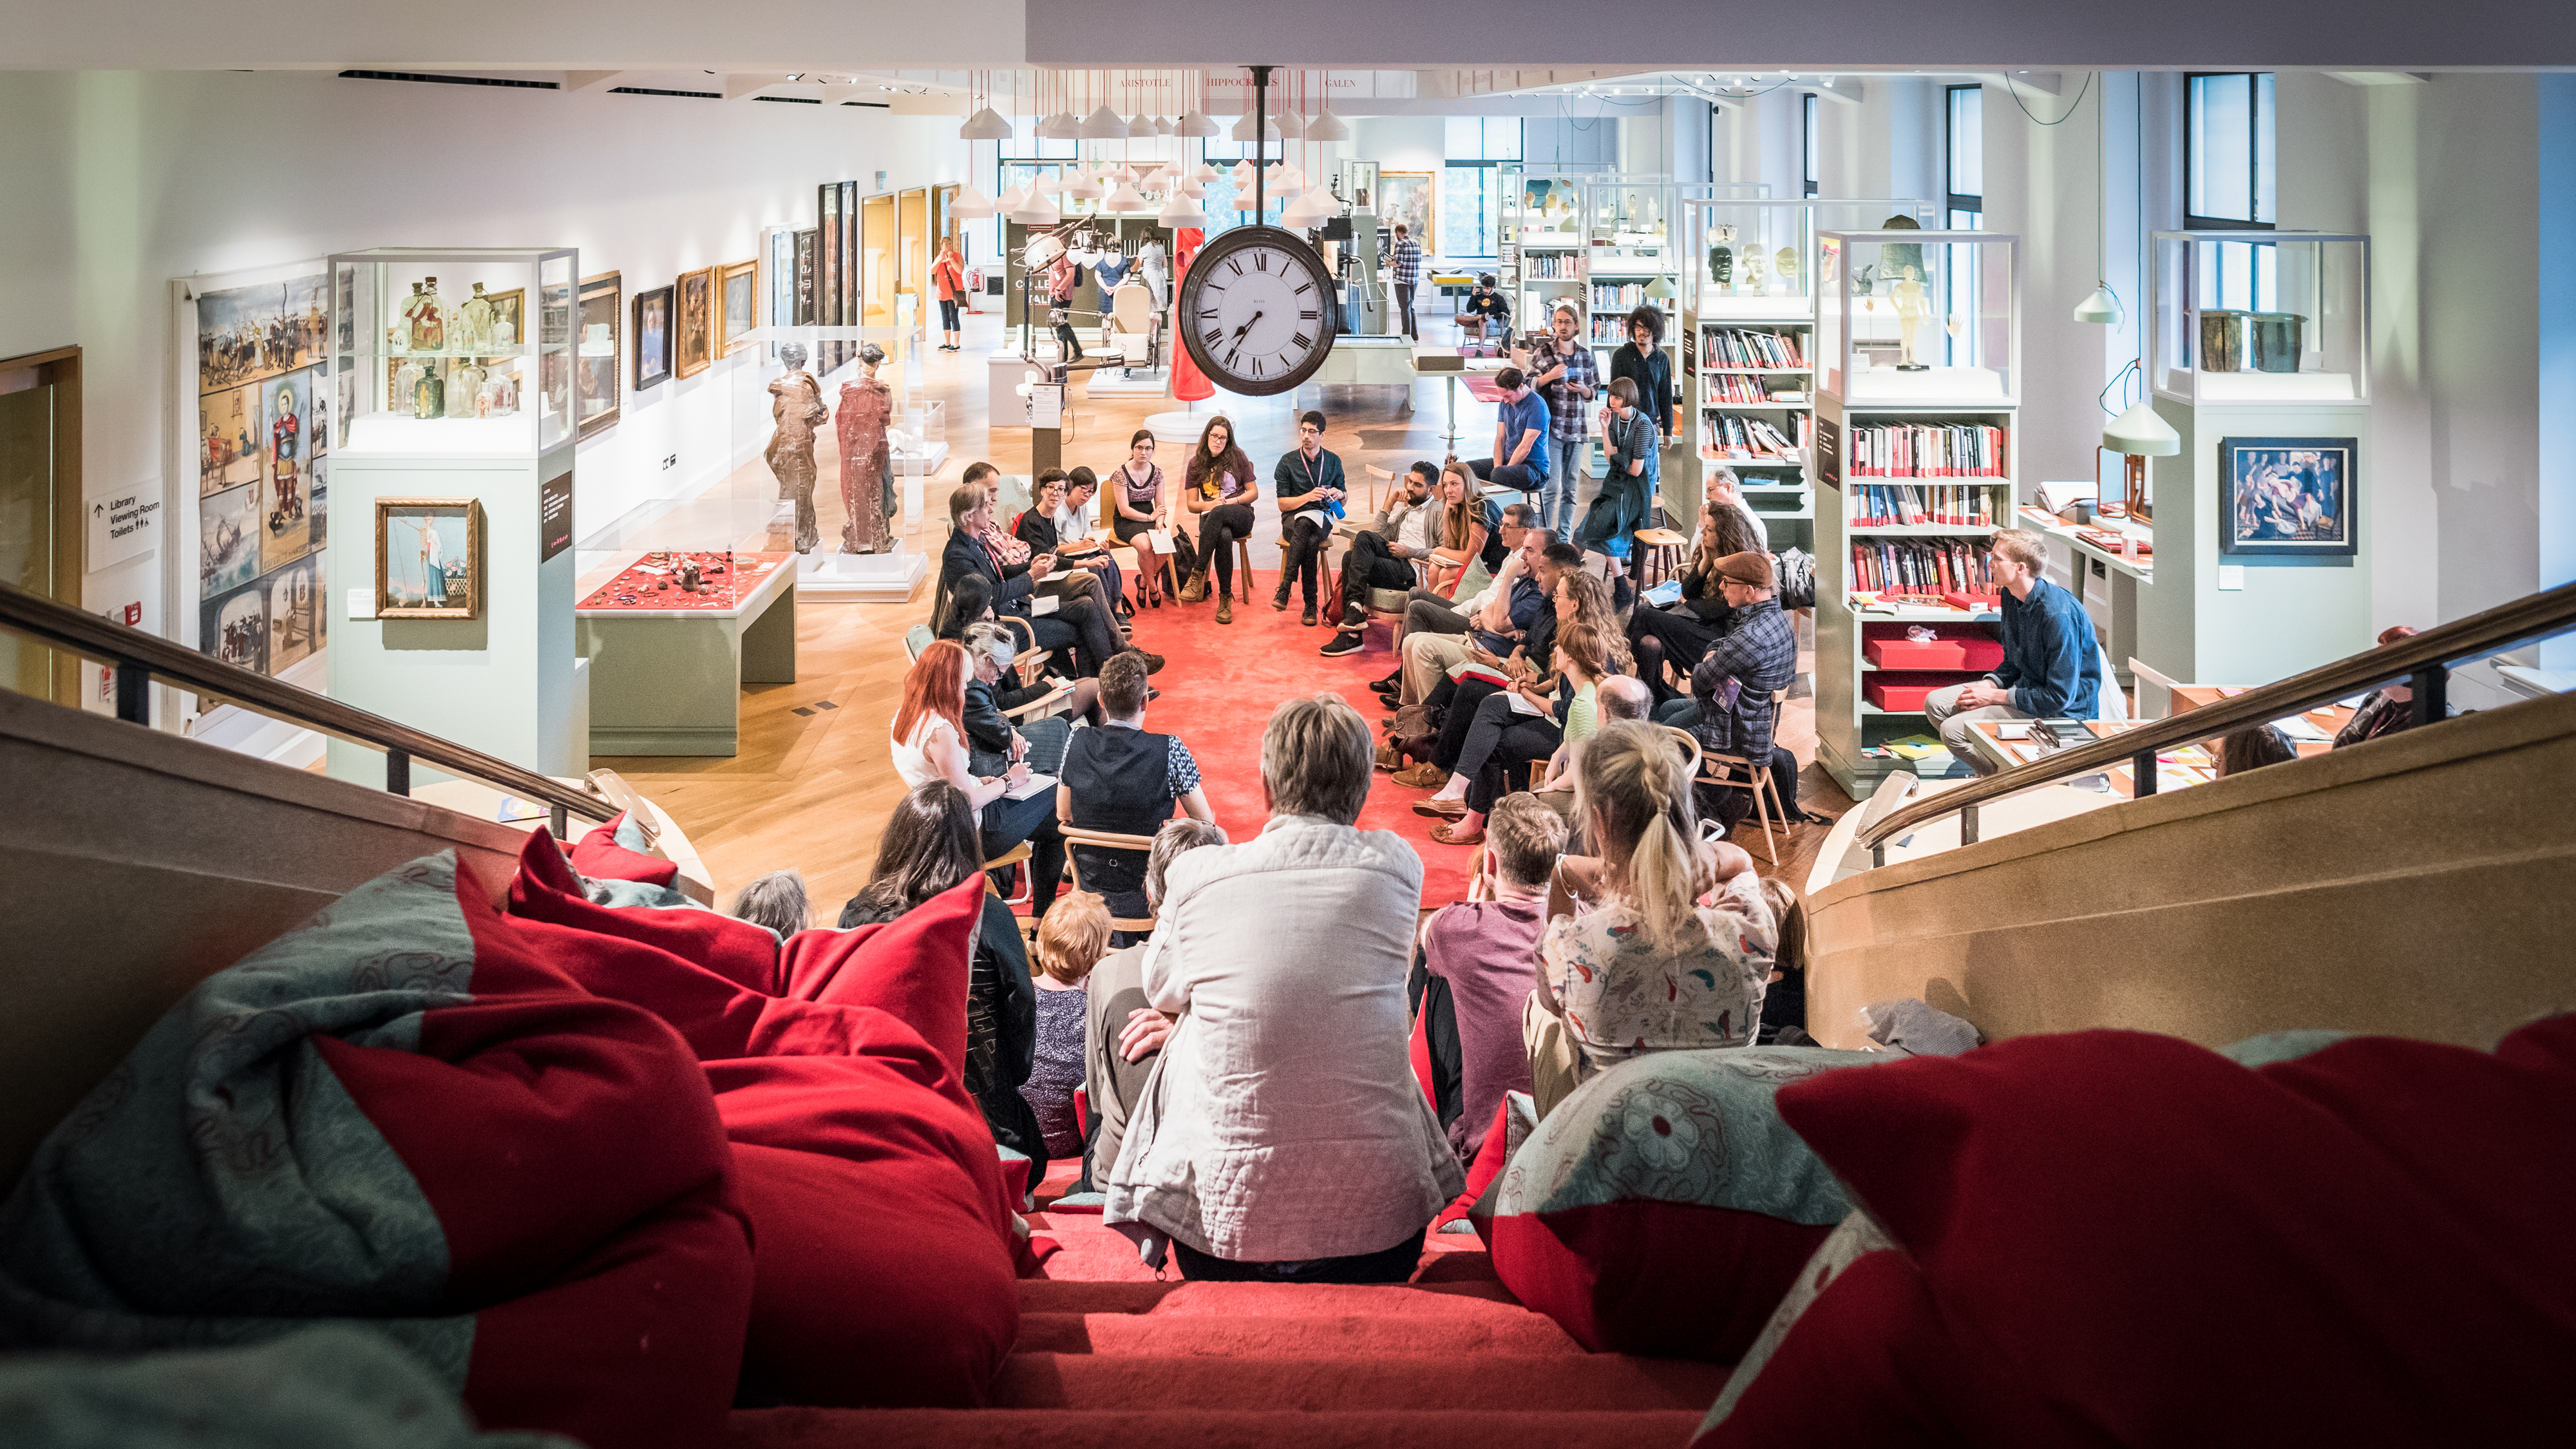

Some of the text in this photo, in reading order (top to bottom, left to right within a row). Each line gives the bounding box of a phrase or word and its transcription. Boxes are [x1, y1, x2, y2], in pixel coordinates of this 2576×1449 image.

[1119, 79, 1171, 87] ARISTOTLE
[1206, 78, 1278, 86] HIPPOCRES
[1325, 79, 1356, 88] GALEN
[110, 496, 136, 511] Library
[110, 502, 160, 525] Viewing Room
[110, 525, 133, 539] Toilets
